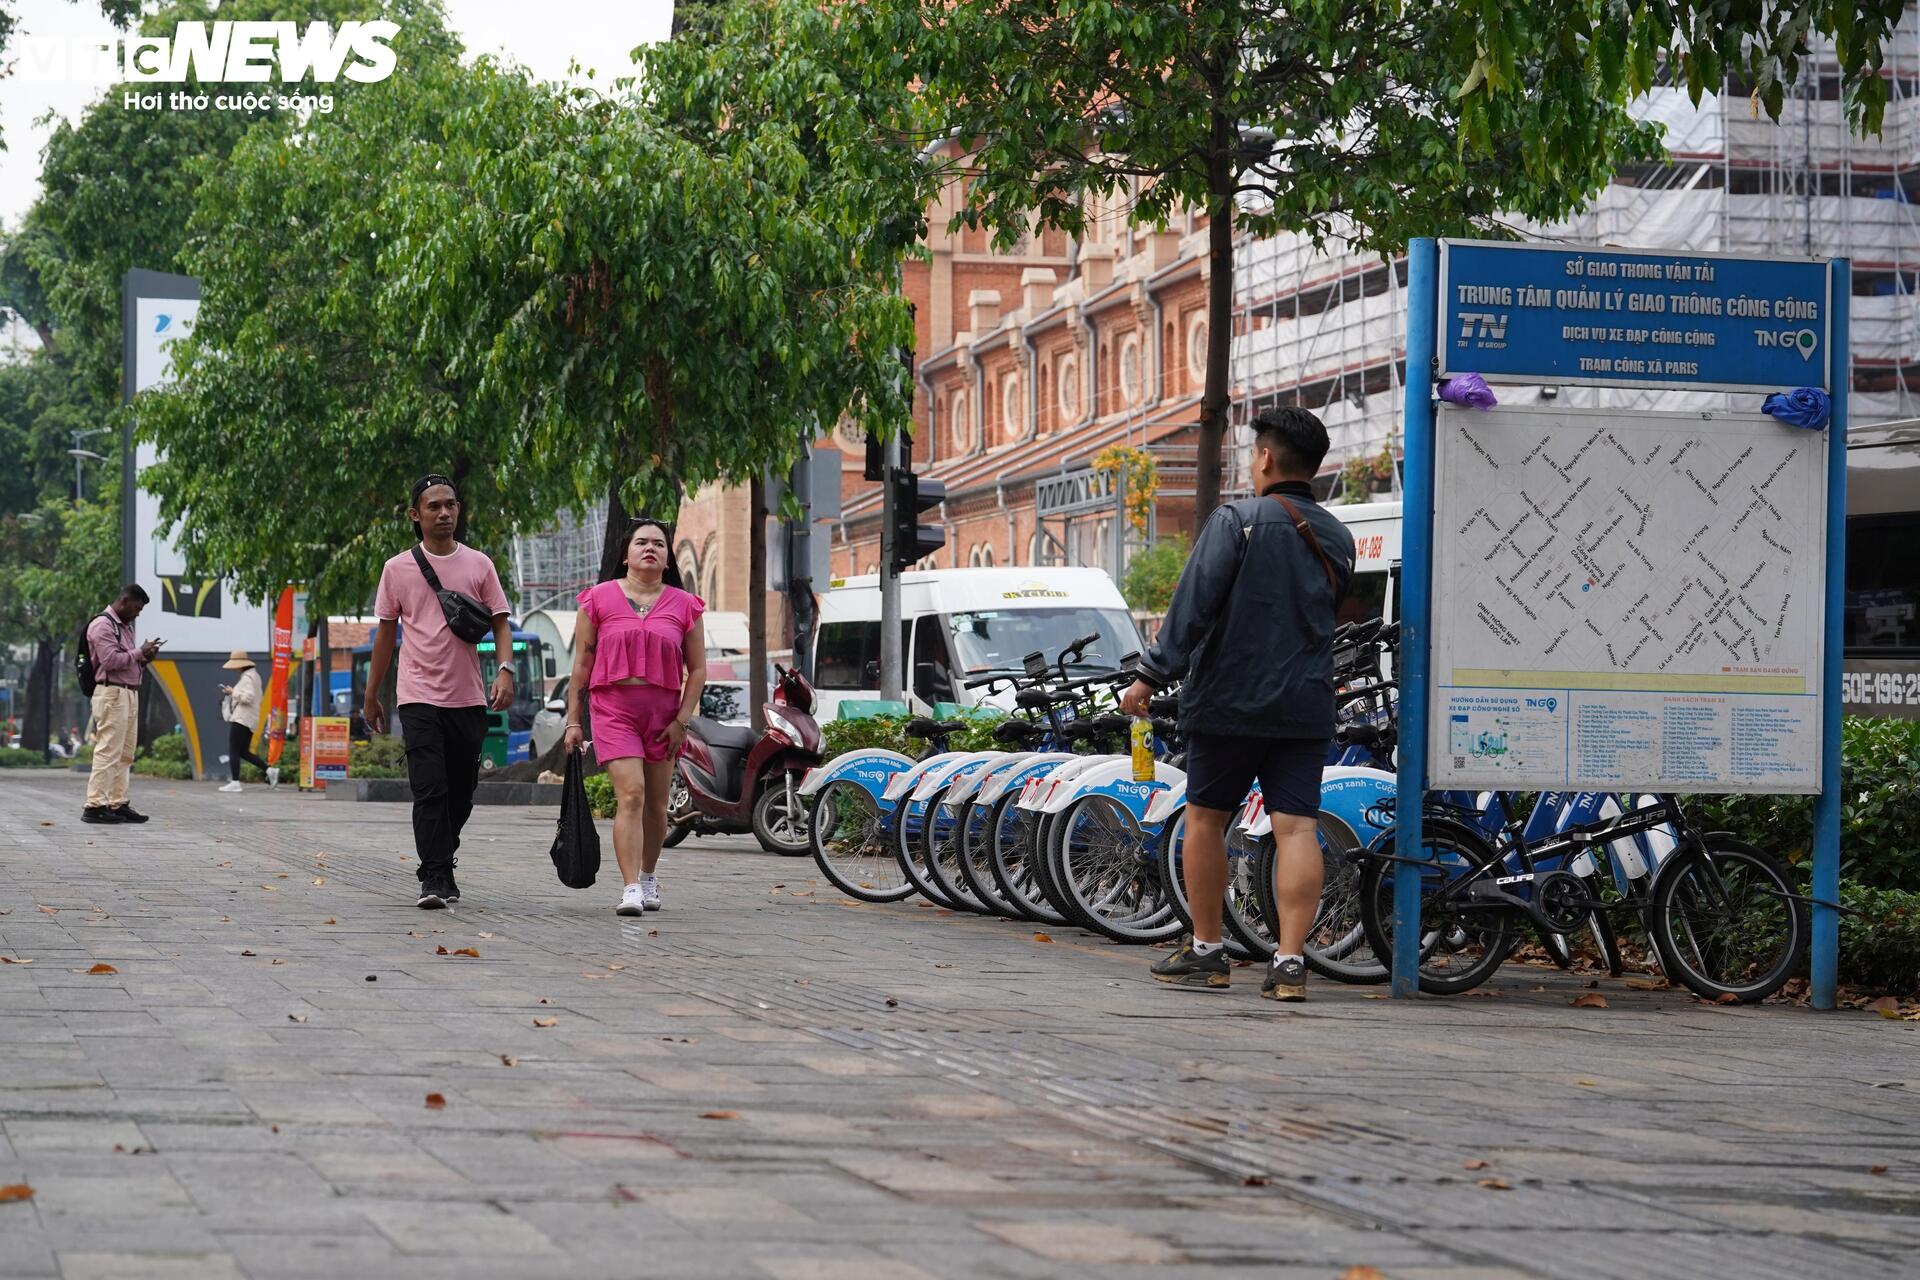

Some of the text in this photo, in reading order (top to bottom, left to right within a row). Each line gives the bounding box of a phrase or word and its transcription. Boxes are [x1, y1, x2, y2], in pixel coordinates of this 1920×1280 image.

[1566, 256, 1584, 275] SỞ
[1587, 262, 1617, 278] GIAO
[1665, 261, 1691, 282] VẬN
[1694, 261, 1714, 281] TẢI
[1458, 284, 1817, 322] TRUNG TÂM QUẢN LÝ GIAO THÔNG CÔNG CỘNG
[1458, 313, 1508, 339] TN
[1562, 326, 1715, 347] DỊCH VỤ XE ĐẠP CÔNG CỘNG
[1580, 357, 1698, 375] TRẠM CÔNG XÃ PARIS
[1346, 780, 1366, 788] xanh
